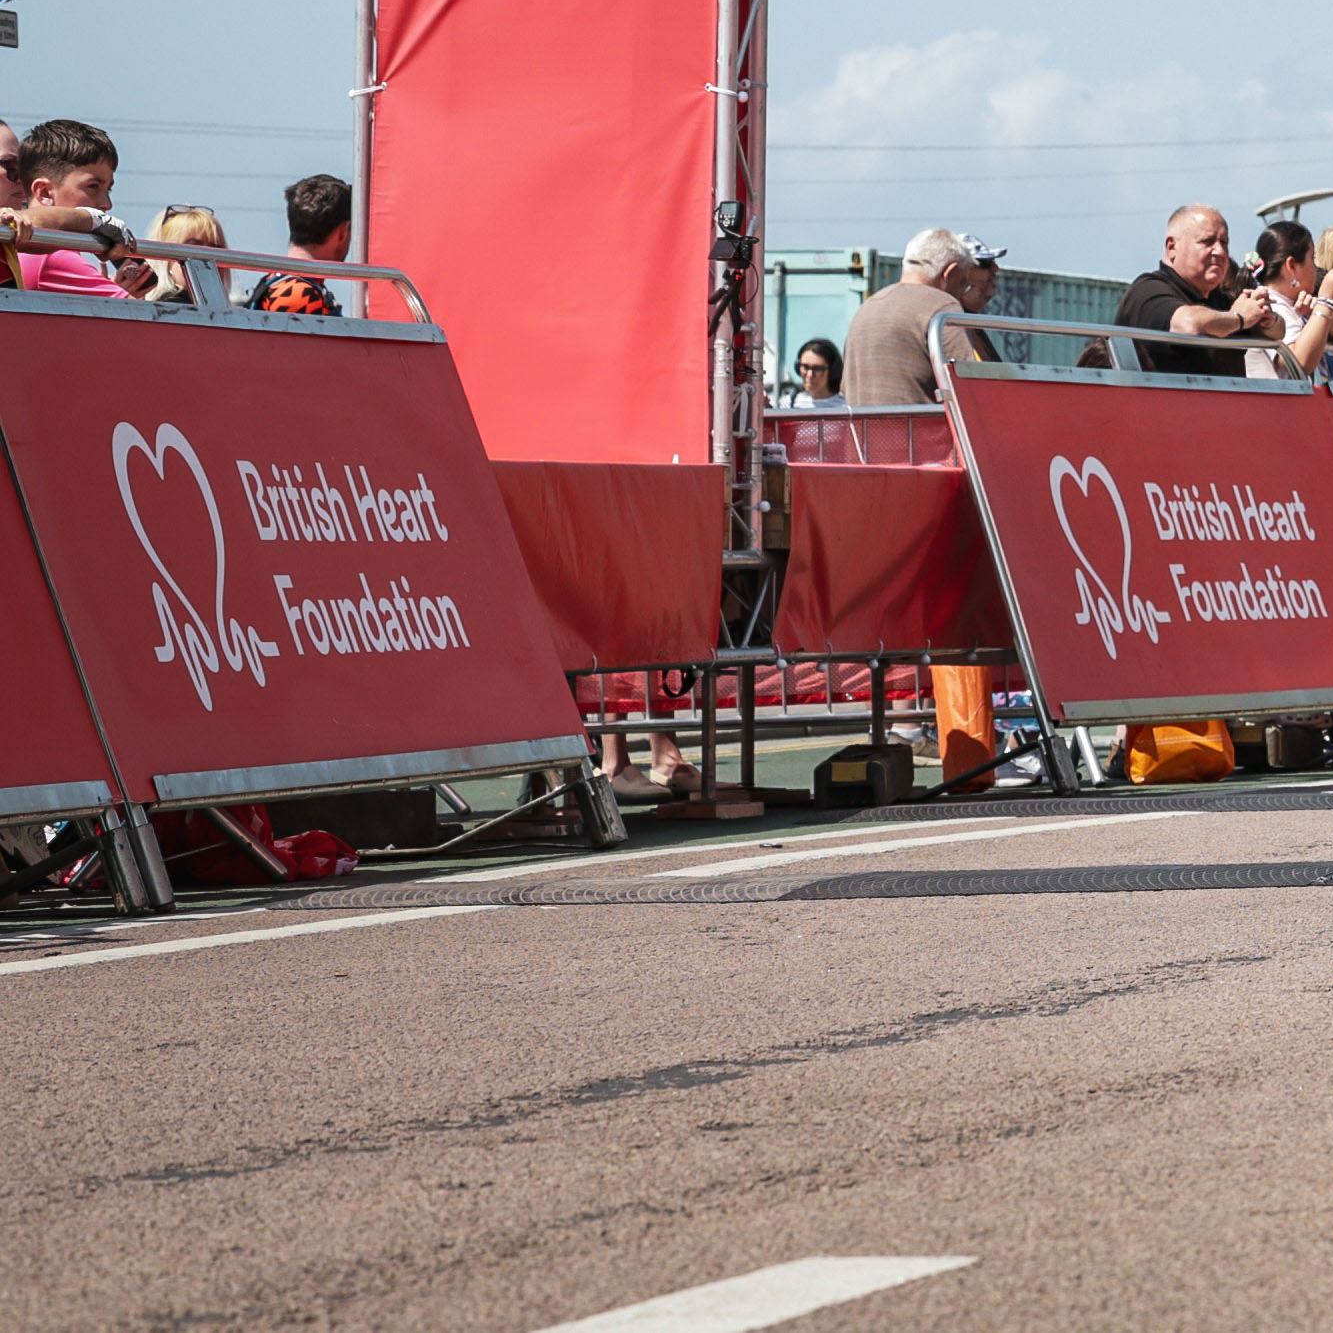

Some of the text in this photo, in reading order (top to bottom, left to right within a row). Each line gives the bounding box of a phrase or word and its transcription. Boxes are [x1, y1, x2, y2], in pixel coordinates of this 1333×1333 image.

[236, 460, 449, 543] British Heart
[1144, 482, 1316, 542] British Heart
[272, 572, 471, 657] Foundation
[1169, 562, 1328, 623] Foundation
